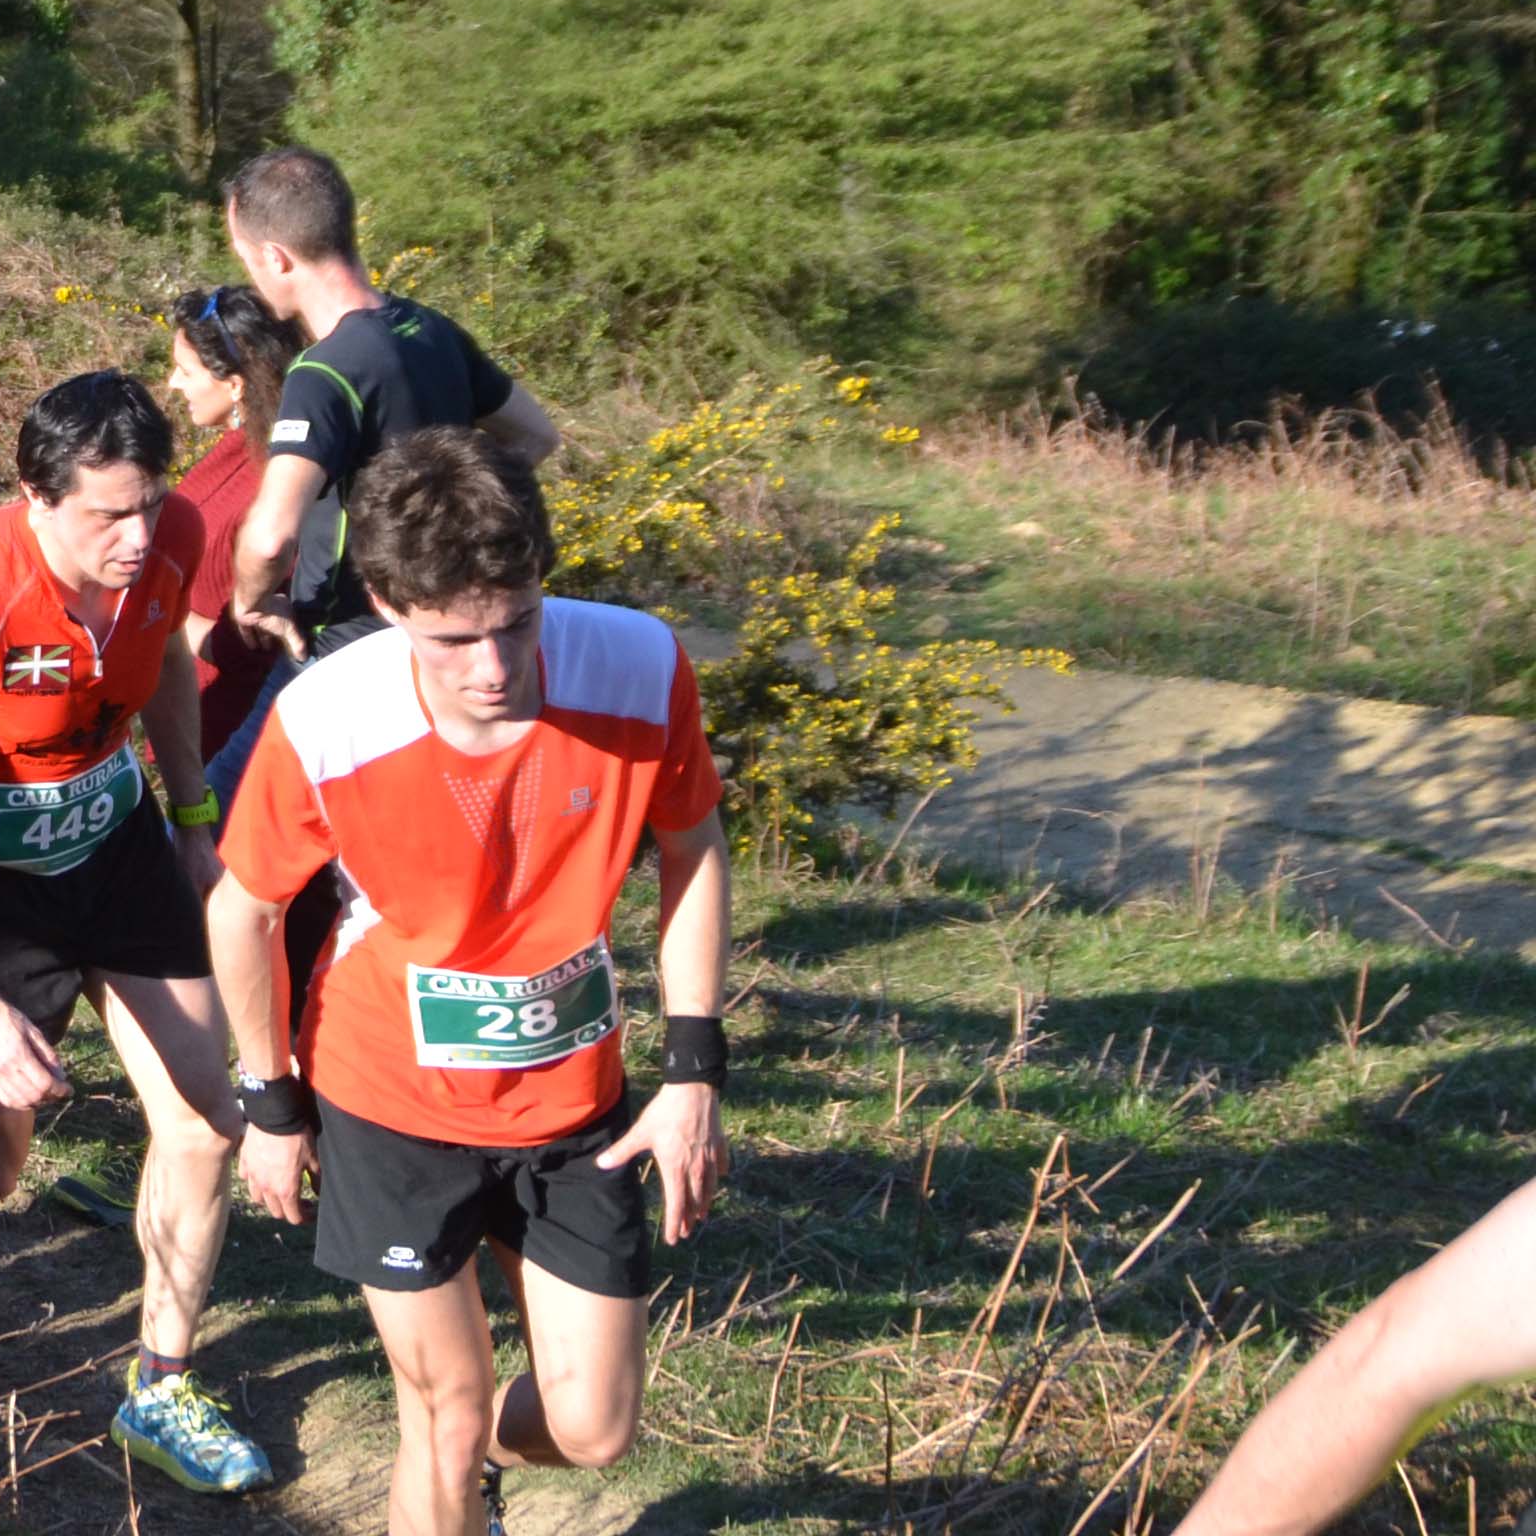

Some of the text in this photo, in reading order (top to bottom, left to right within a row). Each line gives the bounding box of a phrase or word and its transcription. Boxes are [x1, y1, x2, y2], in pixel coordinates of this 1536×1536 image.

[8, 757, 122, 806] CAJA RURAL
[22, 792, 114, 850] 449
[428, 952, 595, 998] CAJA RURAL
[477, 999, 558, 1041] 28
